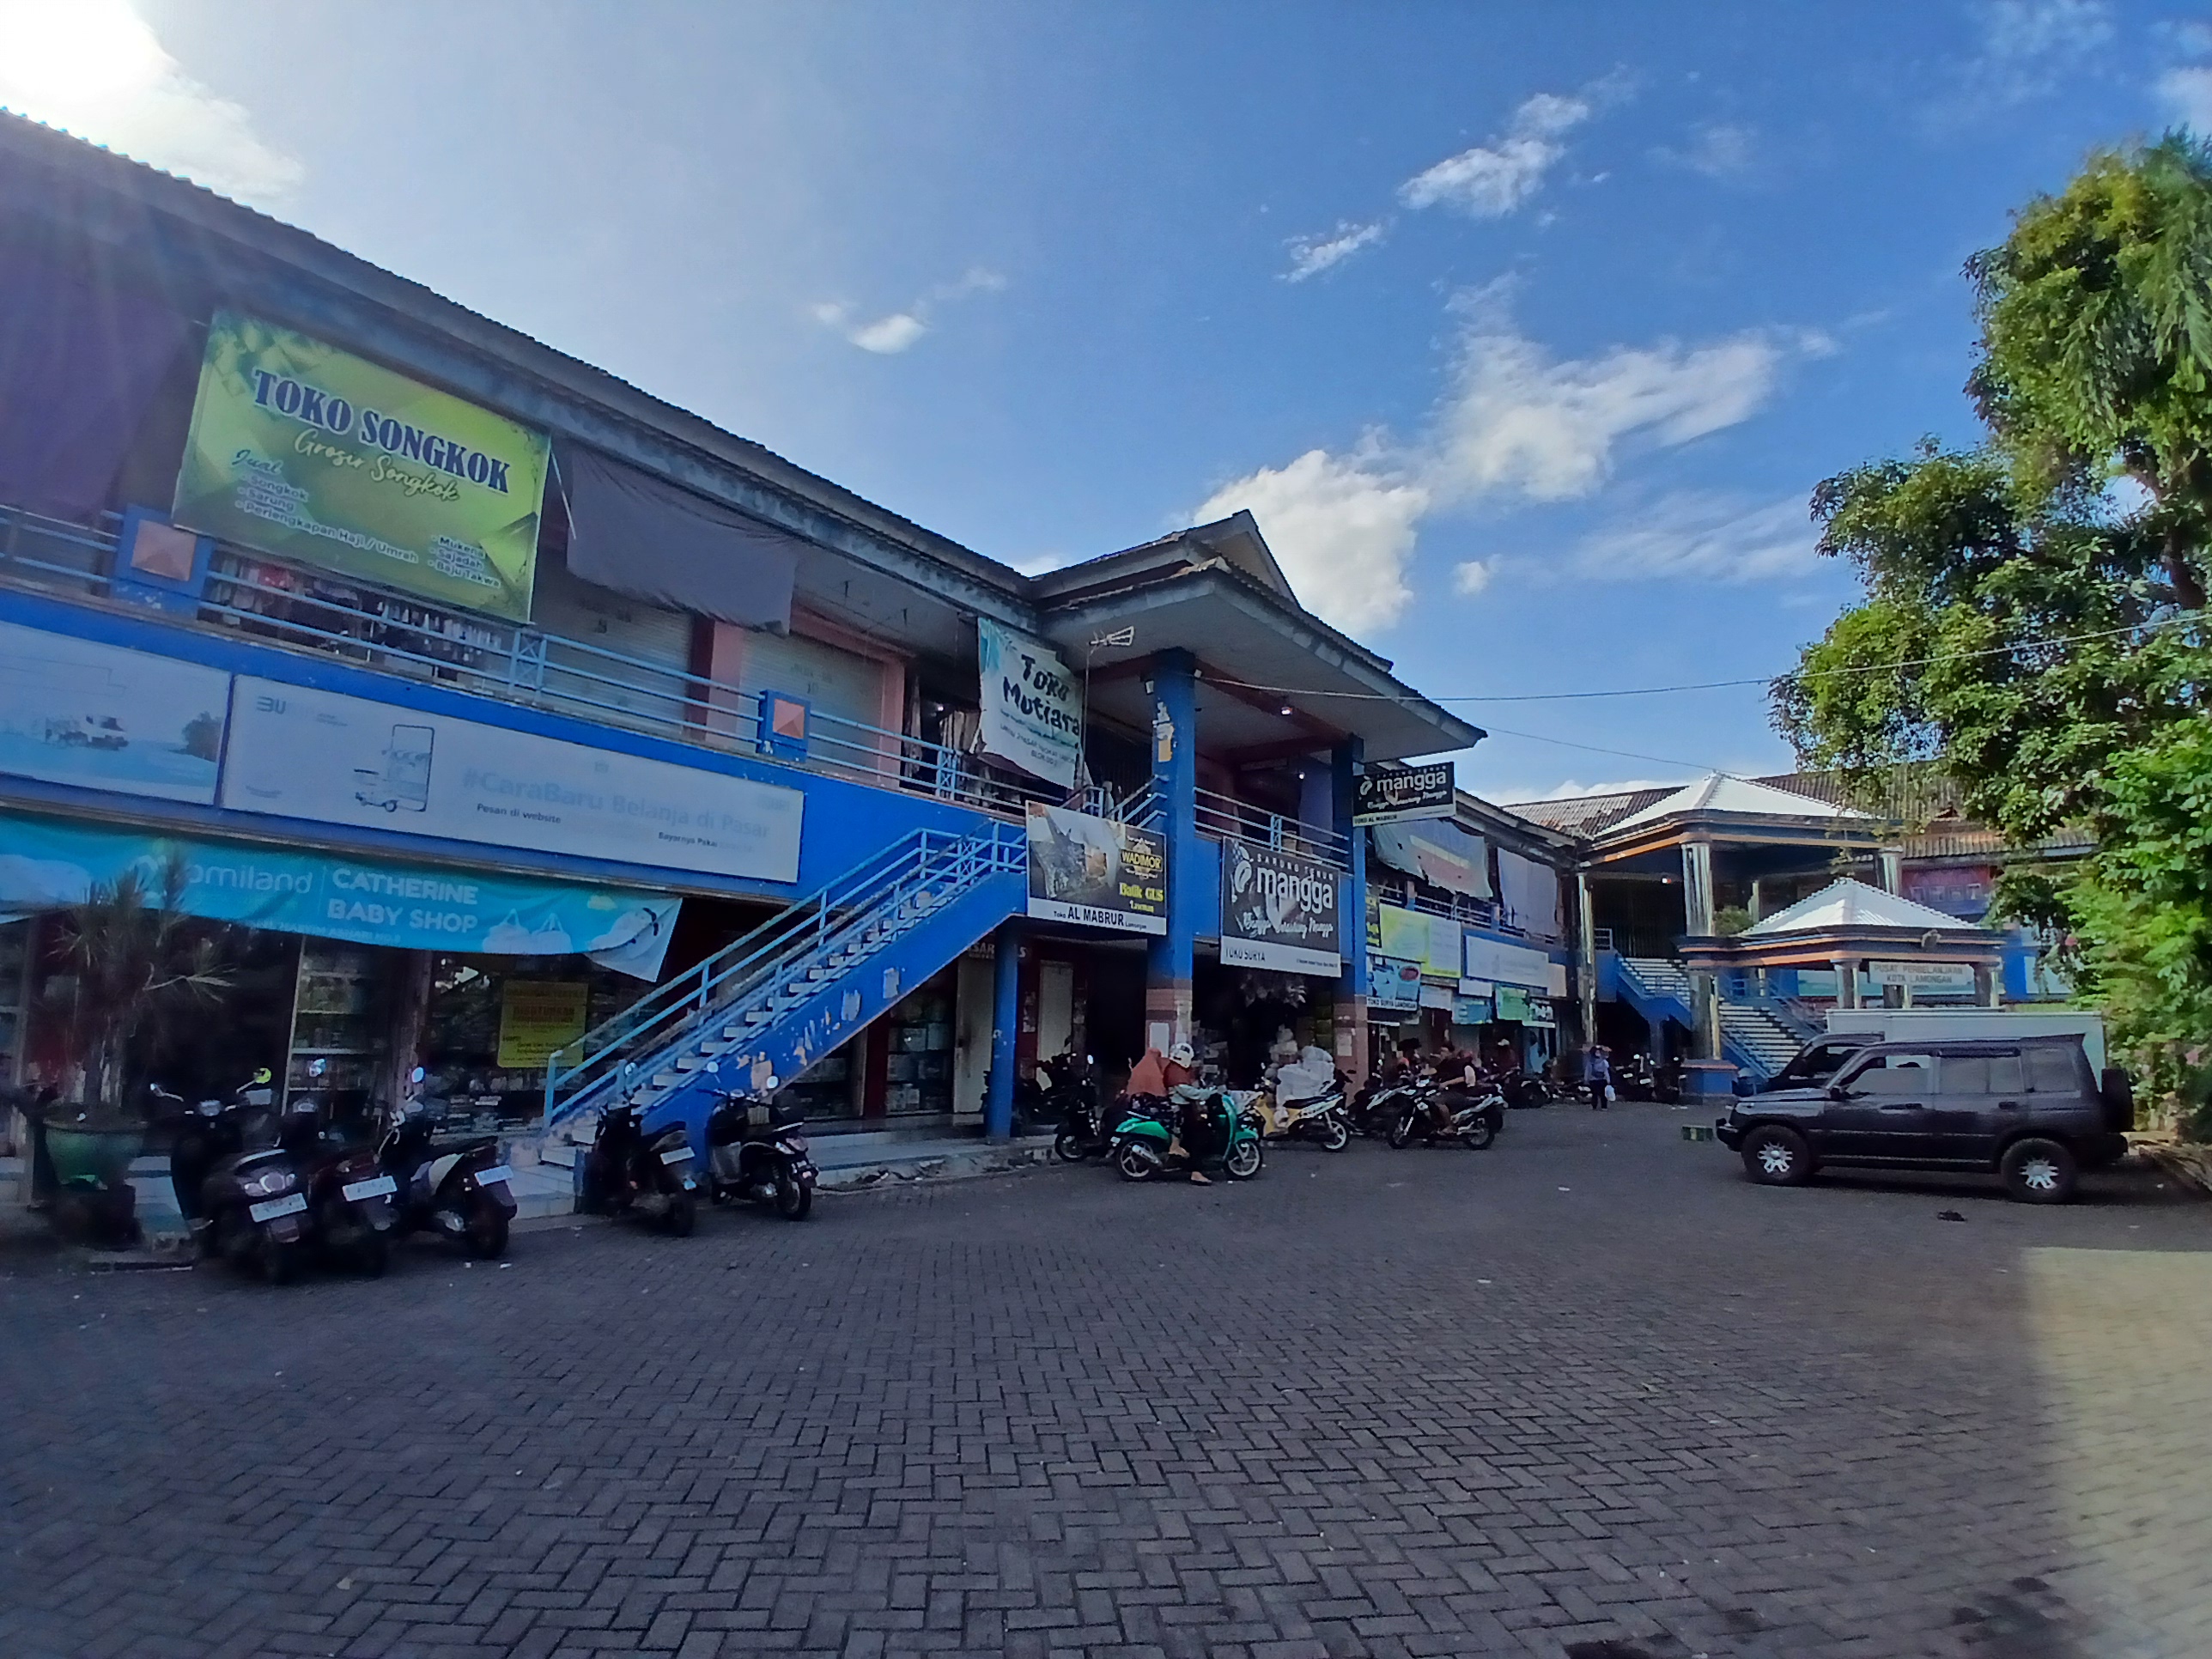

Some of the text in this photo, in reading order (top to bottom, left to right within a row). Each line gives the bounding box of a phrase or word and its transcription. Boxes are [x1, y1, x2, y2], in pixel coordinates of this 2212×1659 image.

[254, 368, 511, 494] TOKO SONGKOK
[232, 448, 283, 474] Jual
[295, 428, 459, 501] Grosir Songkok
[250, 475, 308, 502] Songkok
[248, 489, 295, 513] Sarung
[377, 542, 418, 564] Umrah
[439, 536, 485, 558] Mukena
[438, 548, 483, 570] Sajadah
[1021, 653, 1070, 702] Toko
[1002, 676, 1080, 737] Mutiara
[1377, 771, 1447, 792] mangga
[464, 769, 605, 811] #CaraBaru
[611, 794, 690, 827] Belanja
[696, 808, 714, 829] di
[721, 813, 770, 838] Pasar
[477, 803, 562, 824] Pesan di website
[1122, 851, 1162, 870] WADIMOR
[1257, 854, 1299, 872] SARUNG
[332, 868, 478, 905] CATHERINE
[1257, 867, 1333, 914] mangga
[327, 898, 478, 934] BABY SHOP
[1067, 906, 1080, 921] AL
[1083, 908, 1124, 927] MABRUR
[1225, 946, 1266, 962] TOKO SURYA
[1874, 964, 1899, 973] PUSAT
[1887, 974, 1953, 983] KOTA LAMONGAN
